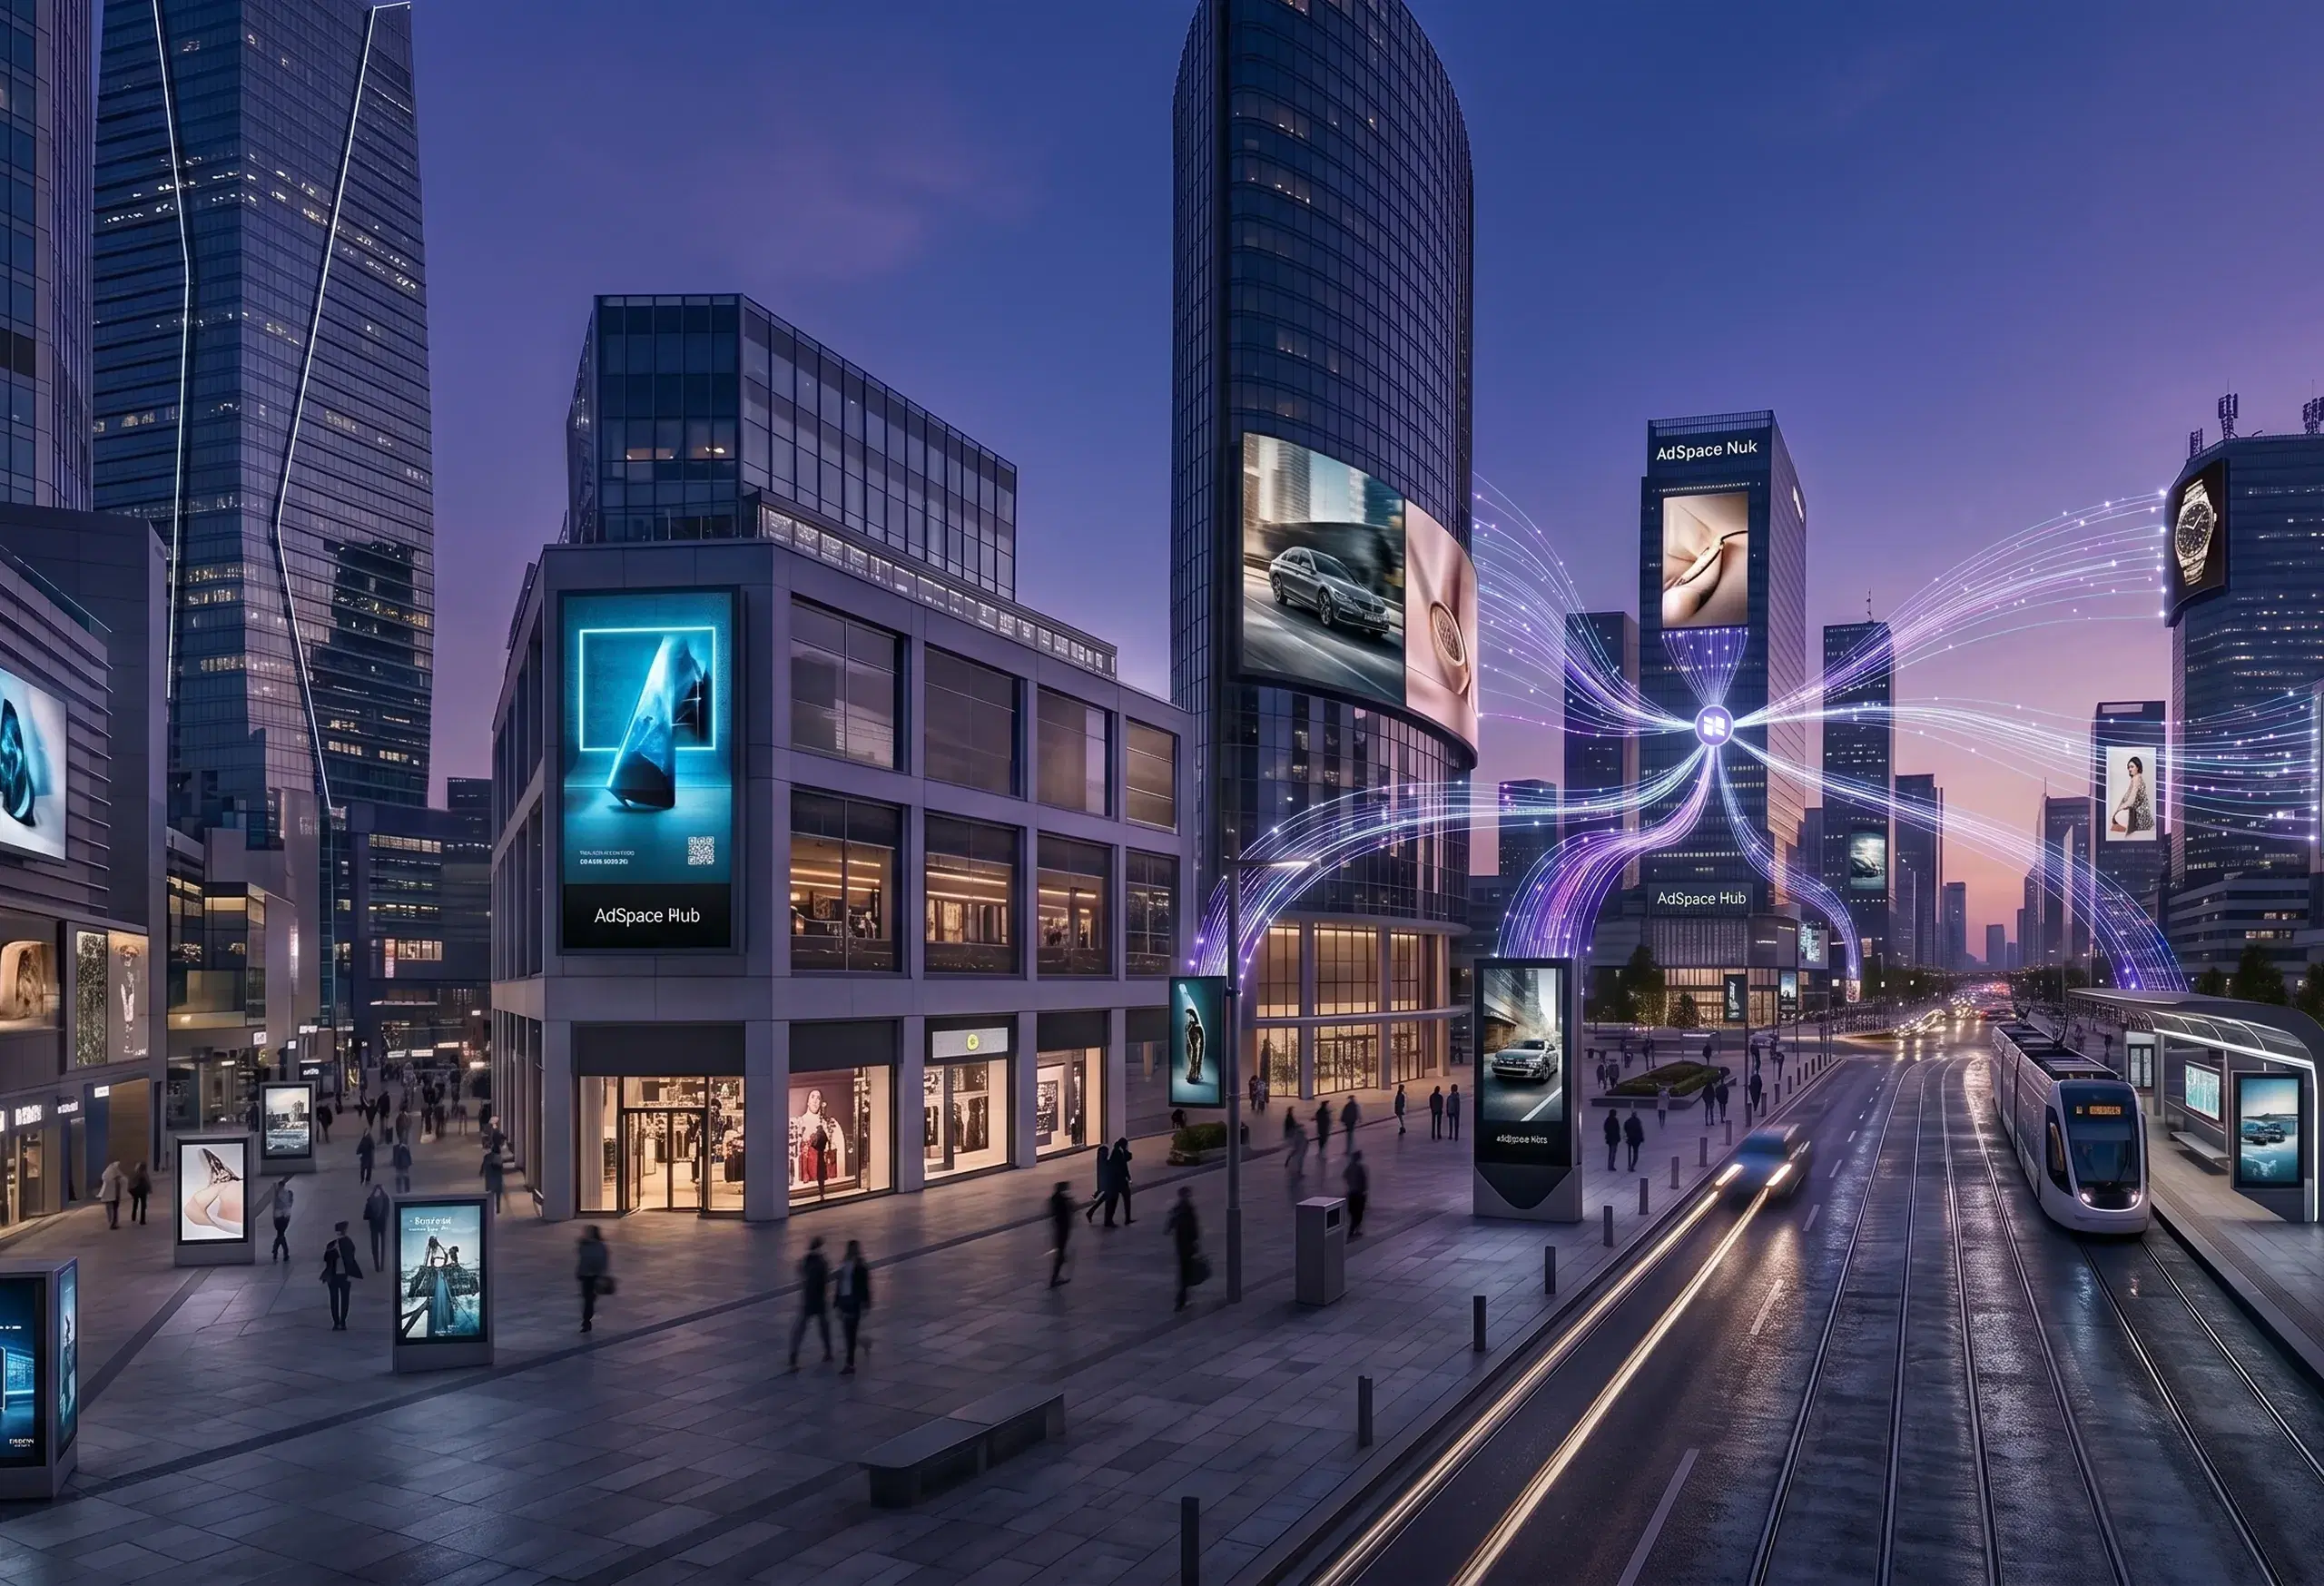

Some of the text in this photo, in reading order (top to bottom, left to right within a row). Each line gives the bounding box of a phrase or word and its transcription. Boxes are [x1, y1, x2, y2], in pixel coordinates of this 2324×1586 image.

[1657, 440, 1757, 461] AdSpace Nuk
[1658, 892, 1746, 907] AdSpace Hub
[595, 908, 663, 927] AdSpace
